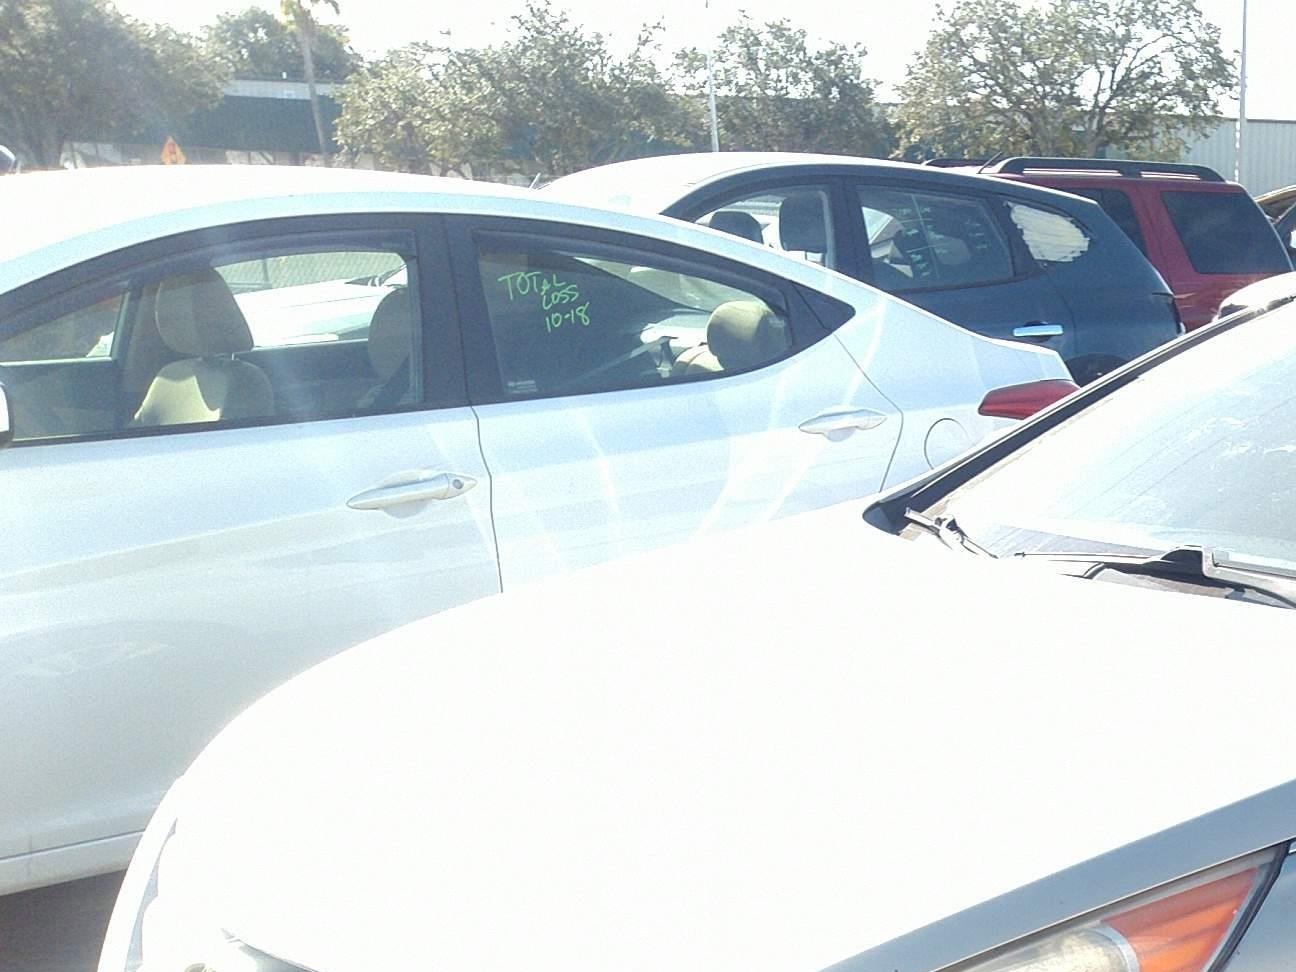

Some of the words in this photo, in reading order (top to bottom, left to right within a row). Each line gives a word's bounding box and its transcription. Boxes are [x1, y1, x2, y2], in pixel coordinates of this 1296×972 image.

[498, 271, 566, 300] TOTAL
[542, 284, 579, 310] LOSS
[545, 301, 590, 333] 10-18
